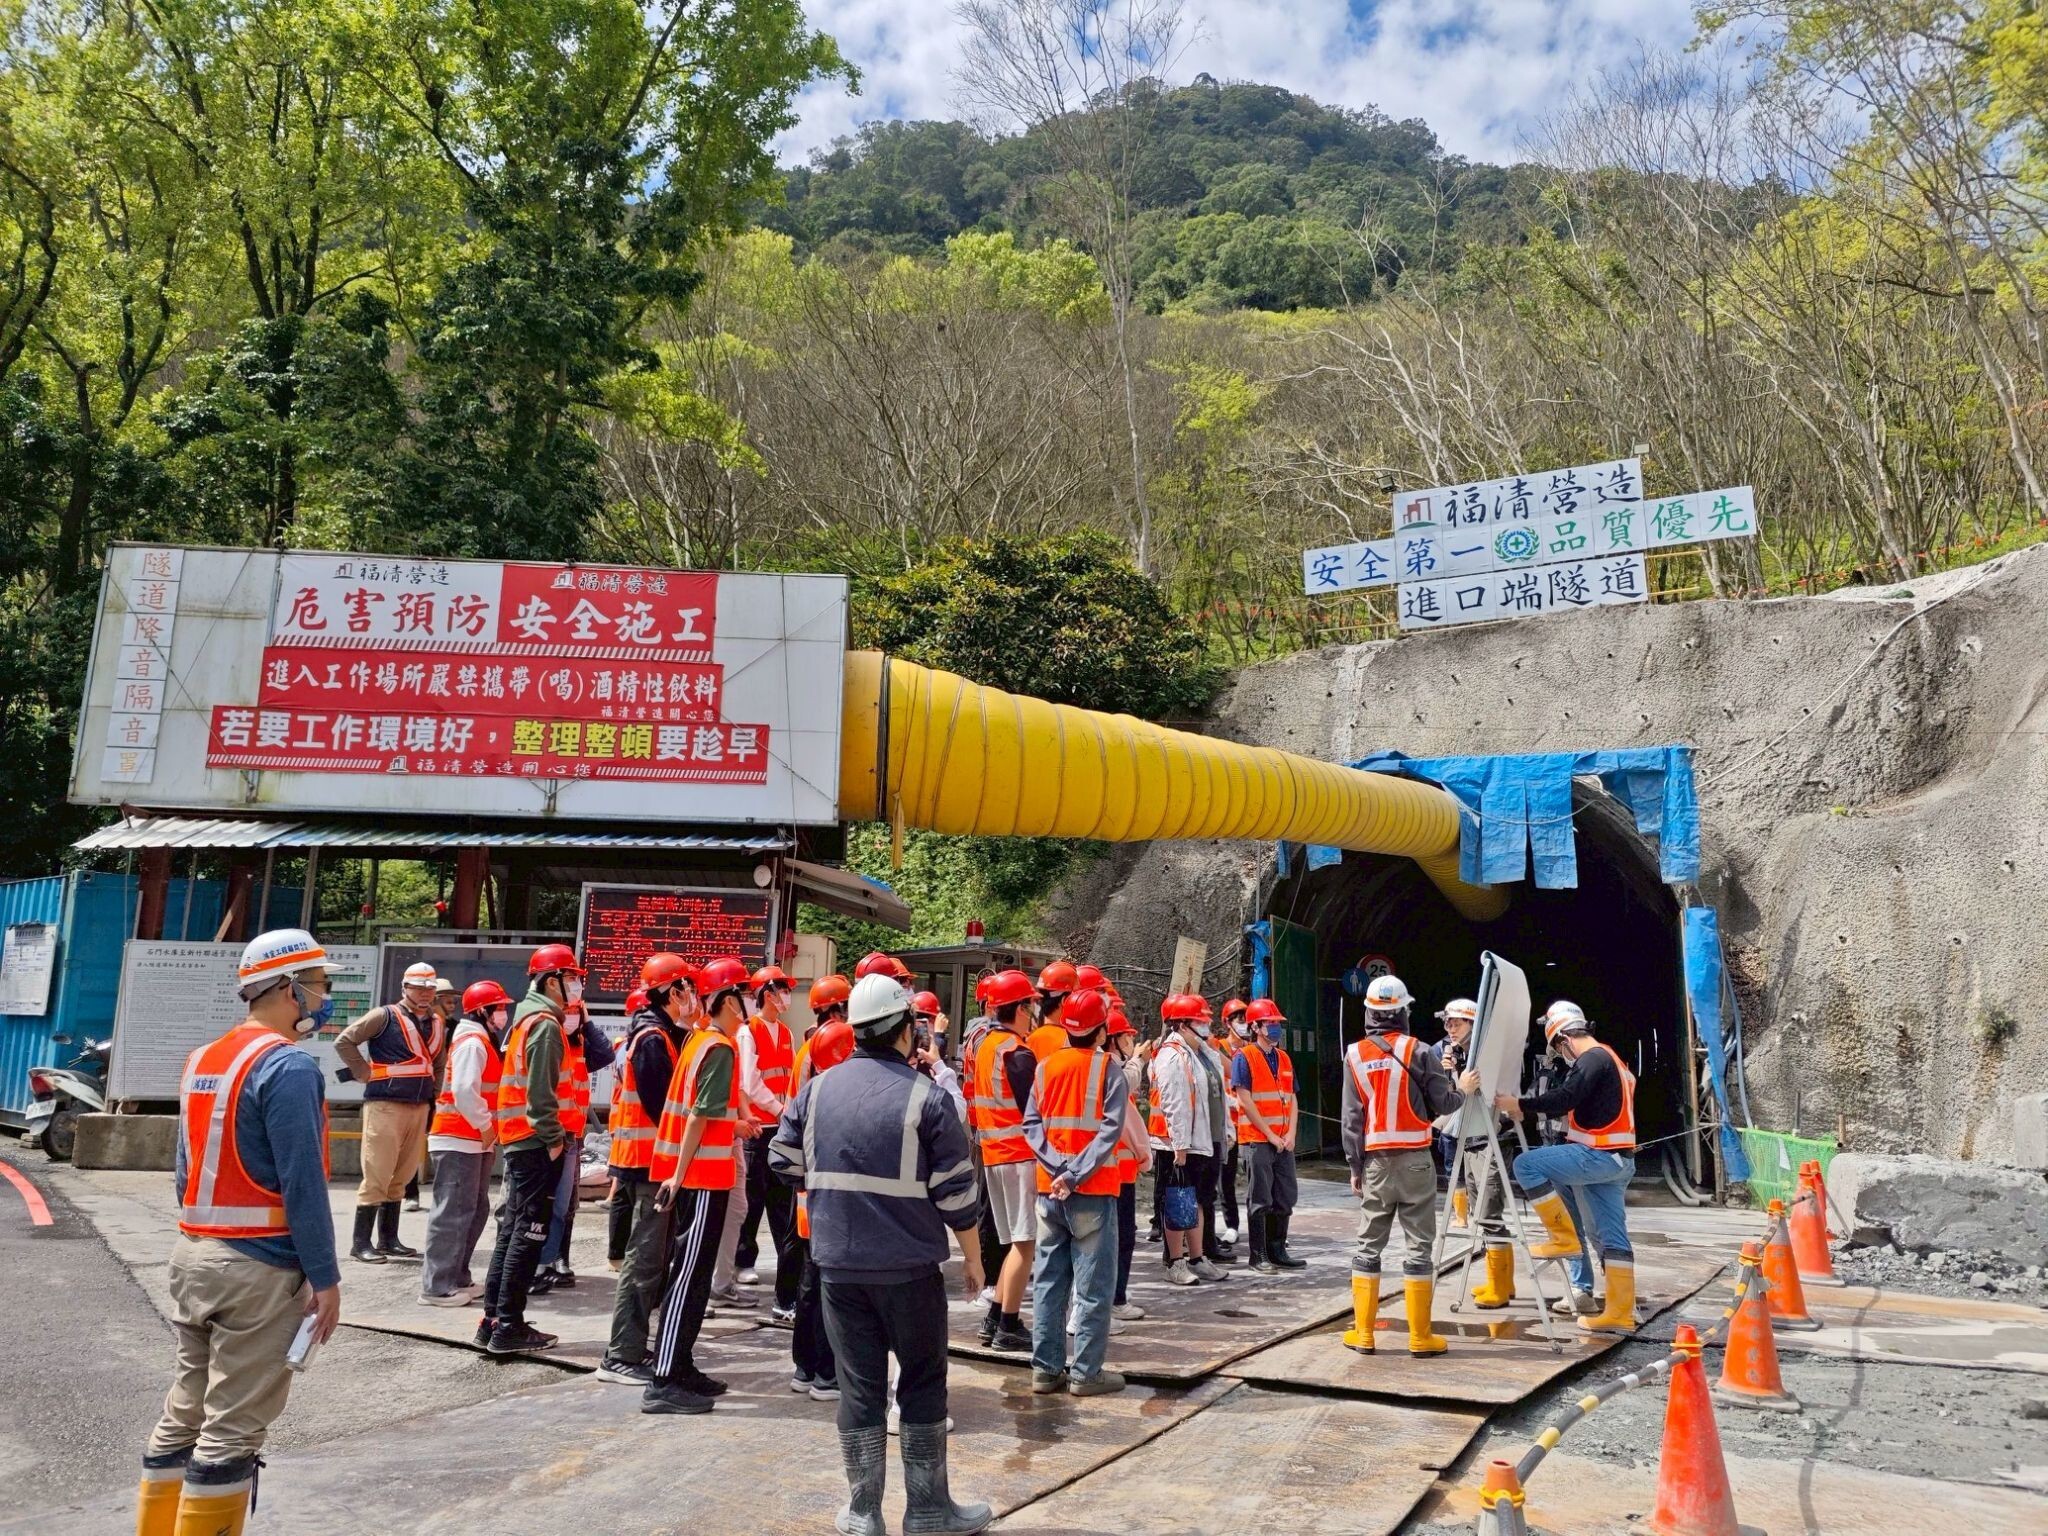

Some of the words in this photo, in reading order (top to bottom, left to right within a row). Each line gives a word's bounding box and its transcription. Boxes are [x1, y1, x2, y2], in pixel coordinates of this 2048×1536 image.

[1445, 463, 1642, 528] 福清營造
[1310, 538, 1485, 587] 安全第一
[1549, 495, 1749, 554] 品質優先
[360, 563, 450, 585] 福清營造
[578, 572, 668, 596] 福清營造
[1402, 557, 1643, 621] 進口端隧道
[284, 587, 490, 637] 危害預防
[510, 594, 708, 644] 安全施工
[601, 706, 715, 721] 福清營造關心您
[417, 758, 592, 777] 福清營造關心您
[1370, 964, 1387, 978] 25
[530, 1221, 545, 1233] VK
